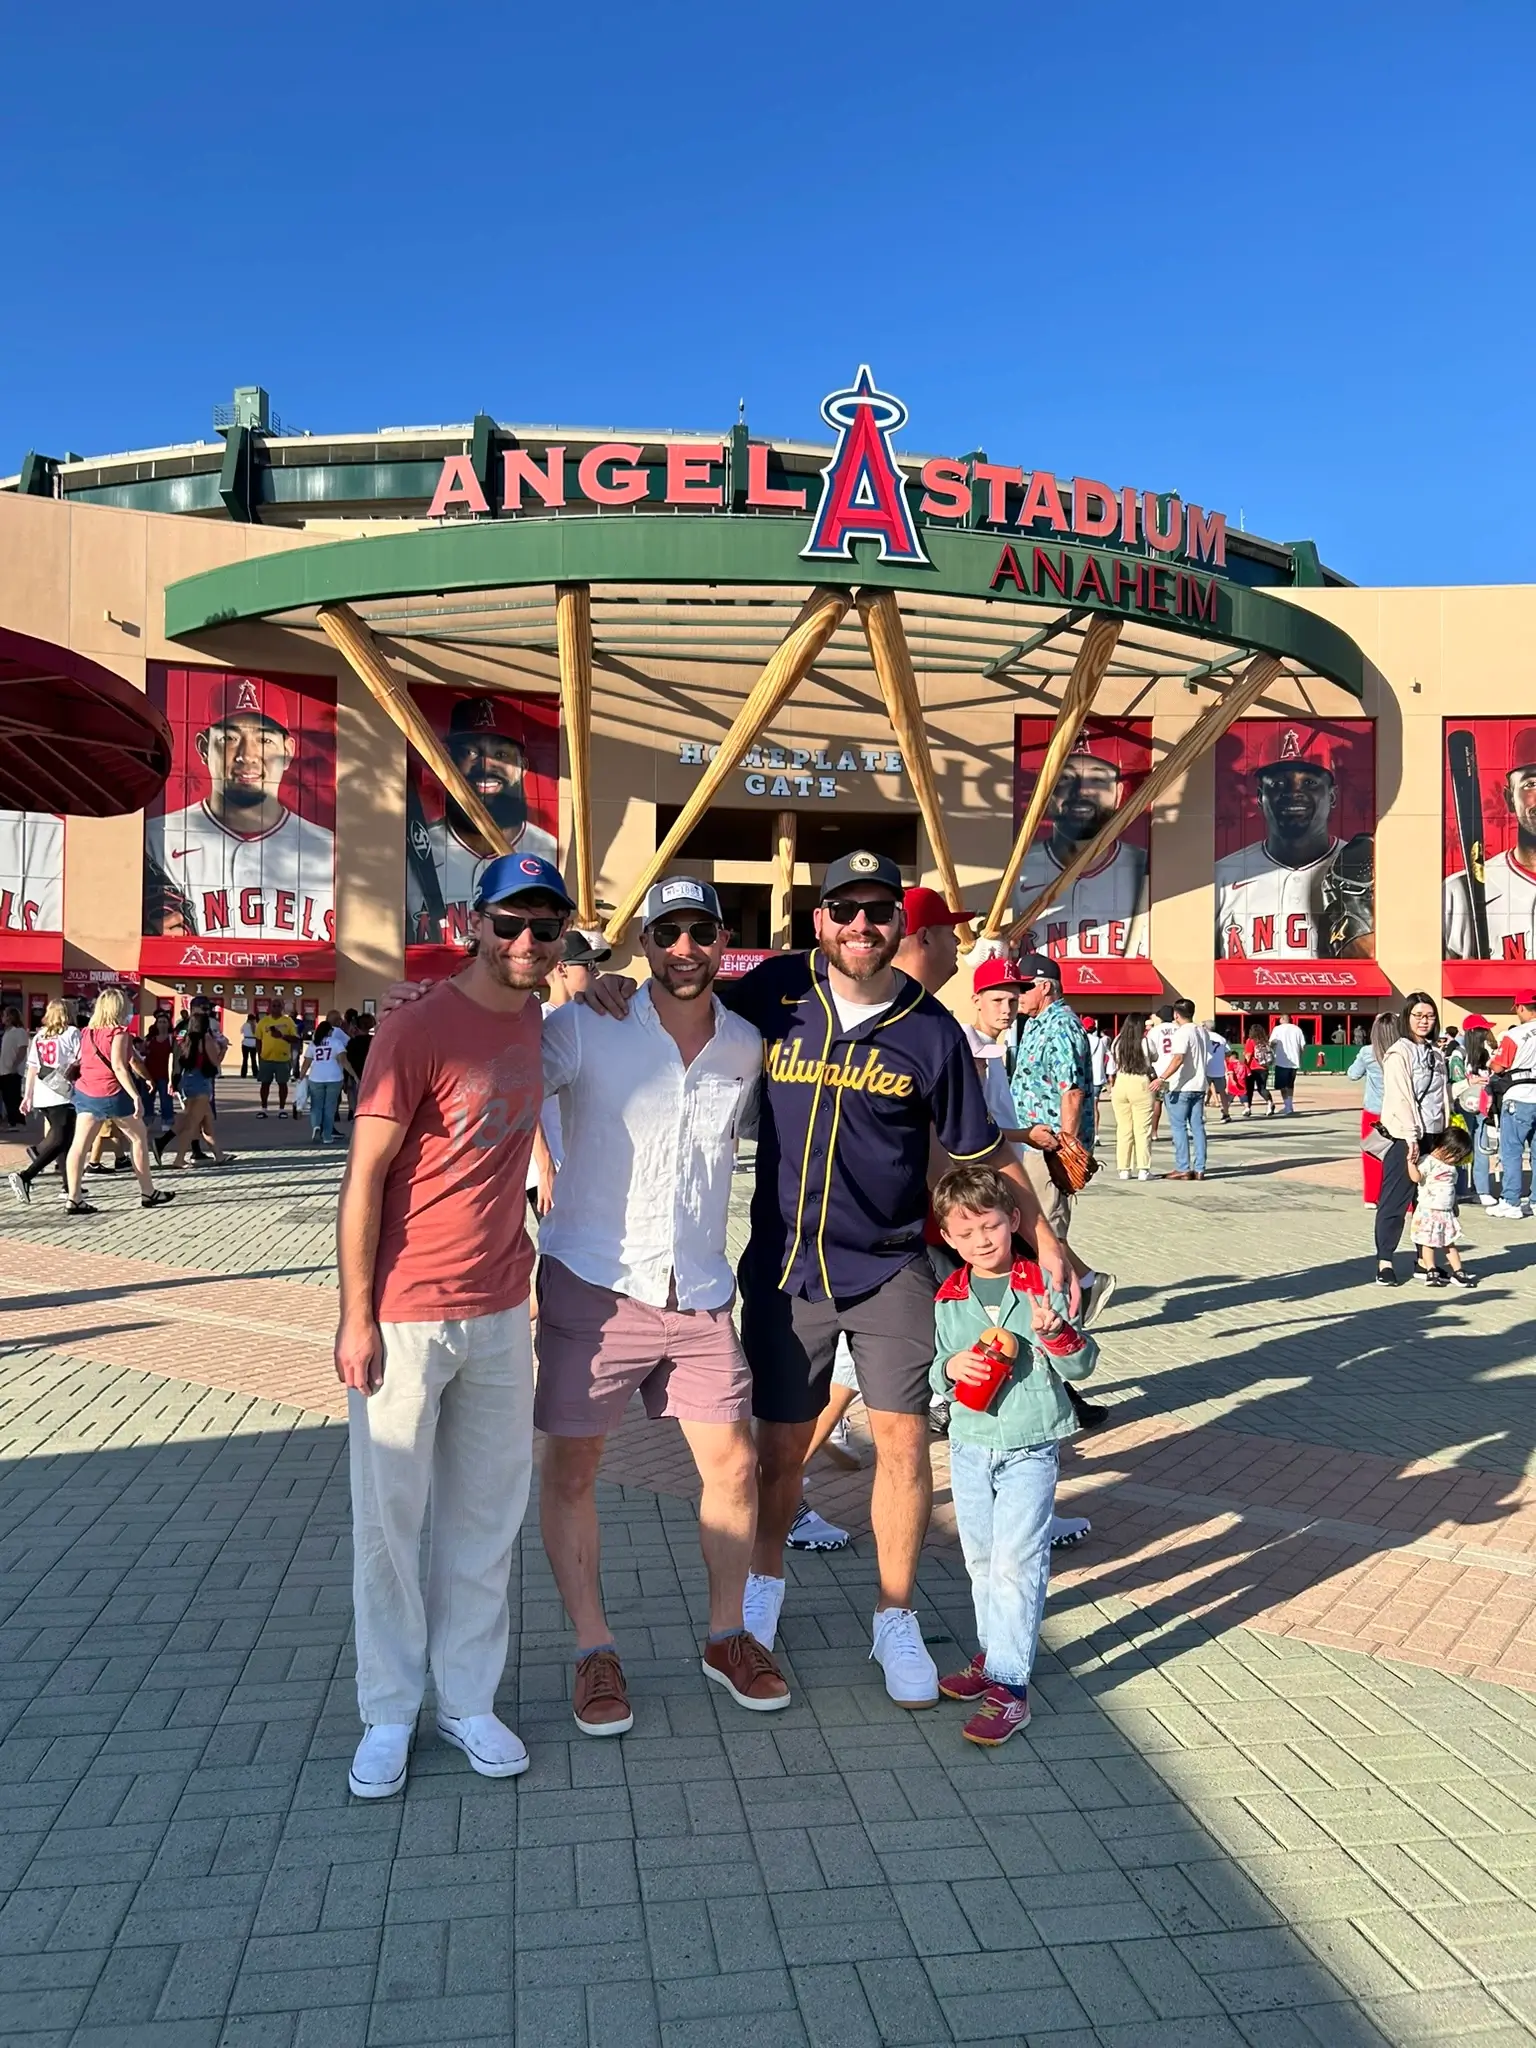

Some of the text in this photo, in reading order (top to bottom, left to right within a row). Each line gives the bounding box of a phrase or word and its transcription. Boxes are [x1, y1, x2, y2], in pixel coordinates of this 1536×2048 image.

[427, 443, 807, 518] ANGEL
[919, 457, 1227, 568] STADIUM
[989, 542, 1218, 624] ANAHEIM
[744, 774, 837, 798] GATE
[180, 944, 300, 969] ANGELS
[736, 954, 764, 963] MOUSE
[1253, 966, 1357, 986] ANGELS
[175, 983, 304, 997] TICKETS
[1230, 1001, 1359, 1011] TEAM STORE
[315, 1047, 332, 1061] 27
